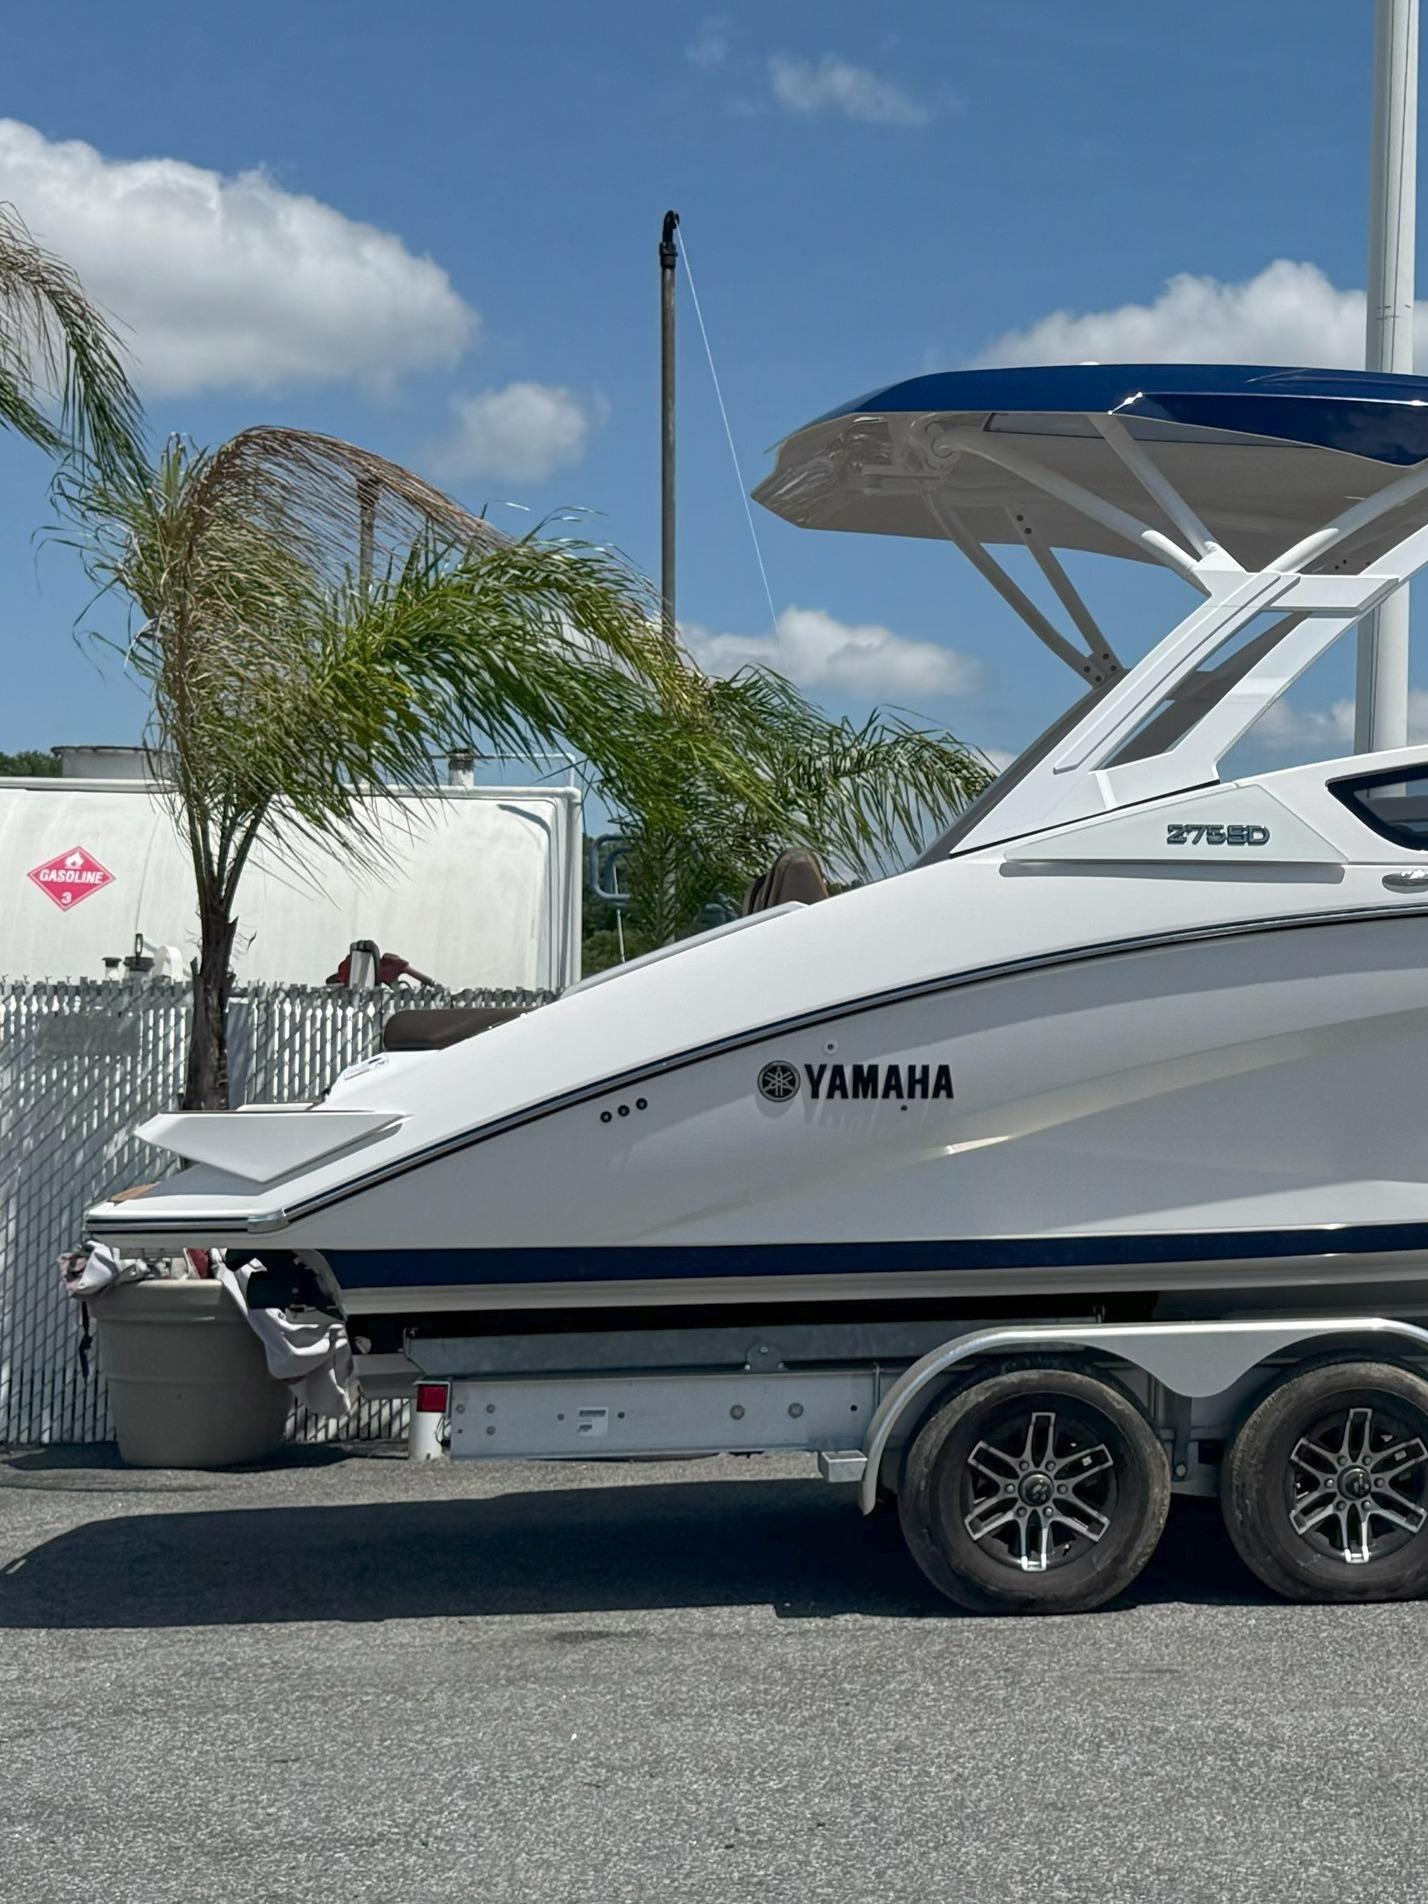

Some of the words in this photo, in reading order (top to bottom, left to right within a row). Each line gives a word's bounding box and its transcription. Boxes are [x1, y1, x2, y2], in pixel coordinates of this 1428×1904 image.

[1167, 824, 1270, 846] 275SD
[39, 868, 104, 884] GASOLINE
[61, 891, 72, 904] 3
[804, 1064, 954, 1099] YAMAHA
